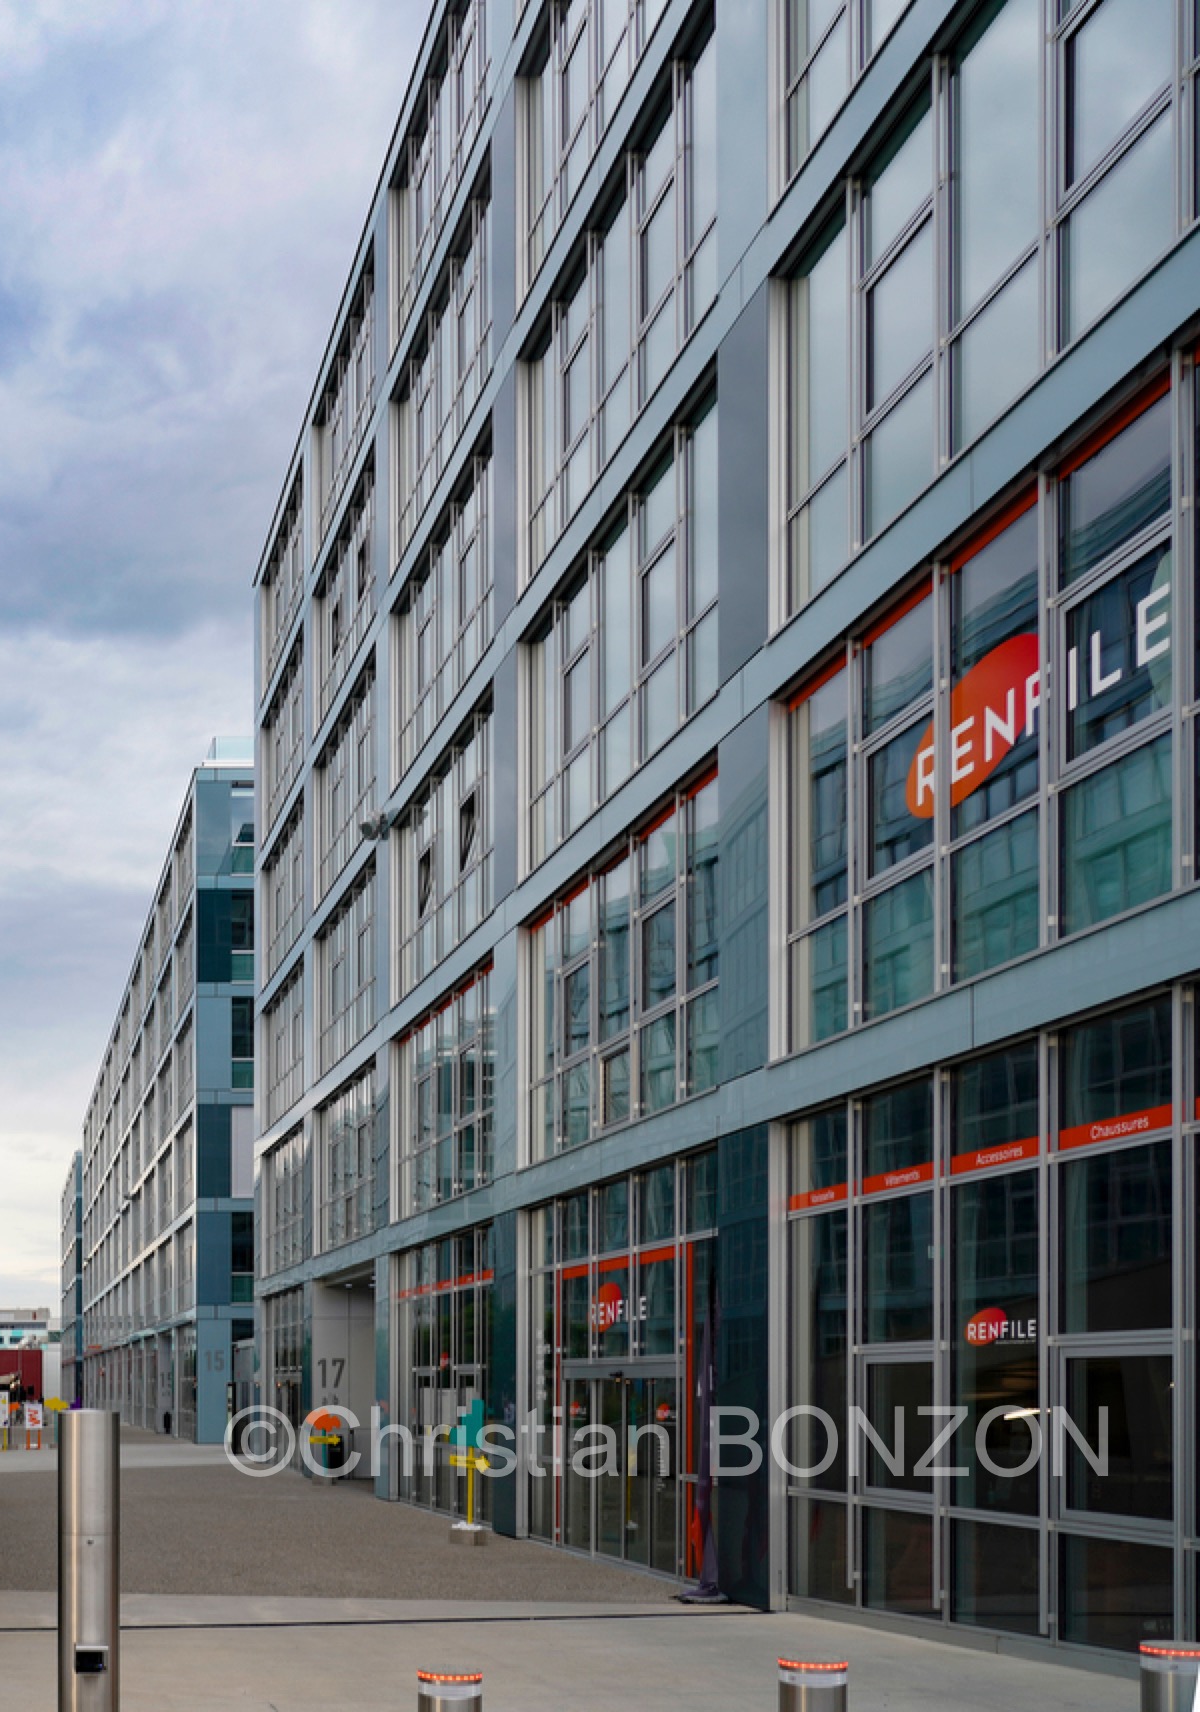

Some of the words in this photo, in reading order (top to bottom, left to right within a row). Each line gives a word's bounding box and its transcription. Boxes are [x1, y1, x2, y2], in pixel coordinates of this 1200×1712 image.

[916, 582, 1170, 807] RENFILE
[1089, 1115, 1149, 1140] Chaussures
[975, 1145, 1024, 1166] Accessoires
[967, 1319, 1037, 1341] RENFILE
[203, 1349, 225, 1372] 15
[317, 1357, 346, 1389] 17
